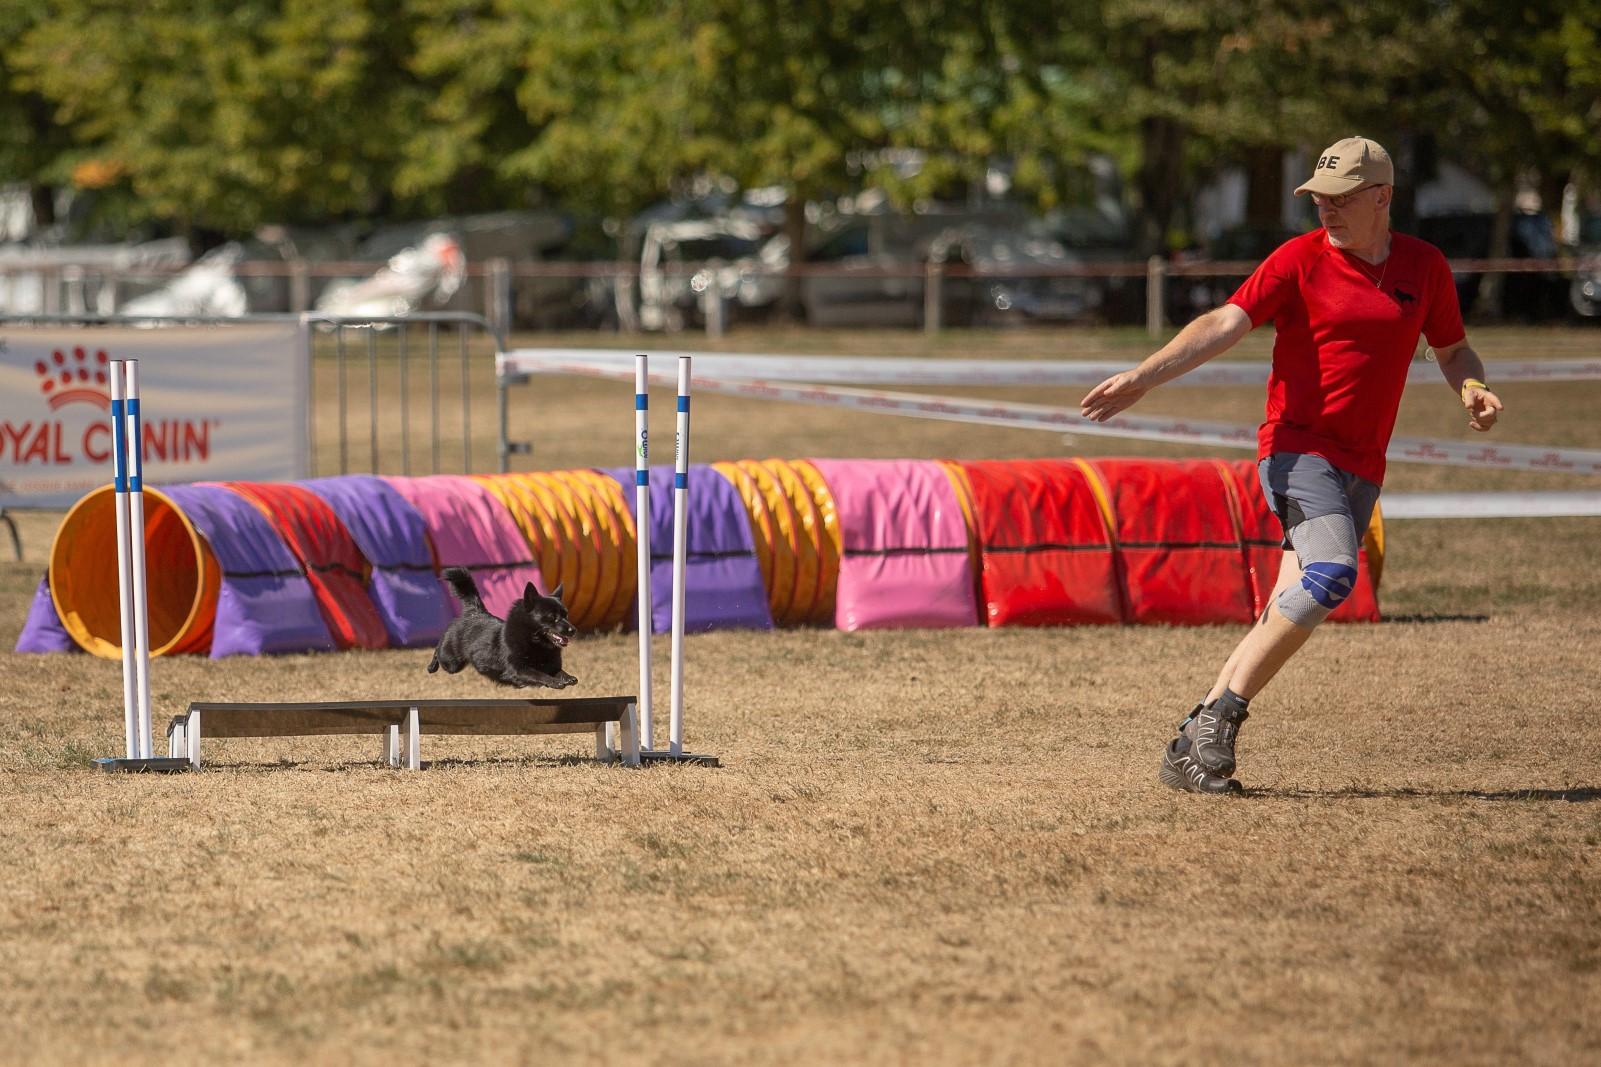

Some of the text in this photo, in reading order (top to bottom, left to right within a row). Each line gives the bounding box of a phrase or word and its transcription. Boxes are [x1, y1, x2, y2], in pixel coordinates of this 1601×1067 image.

[1317, 155, 1340, 169] BE
[0, 420, 210, 464] YAL CNIN
